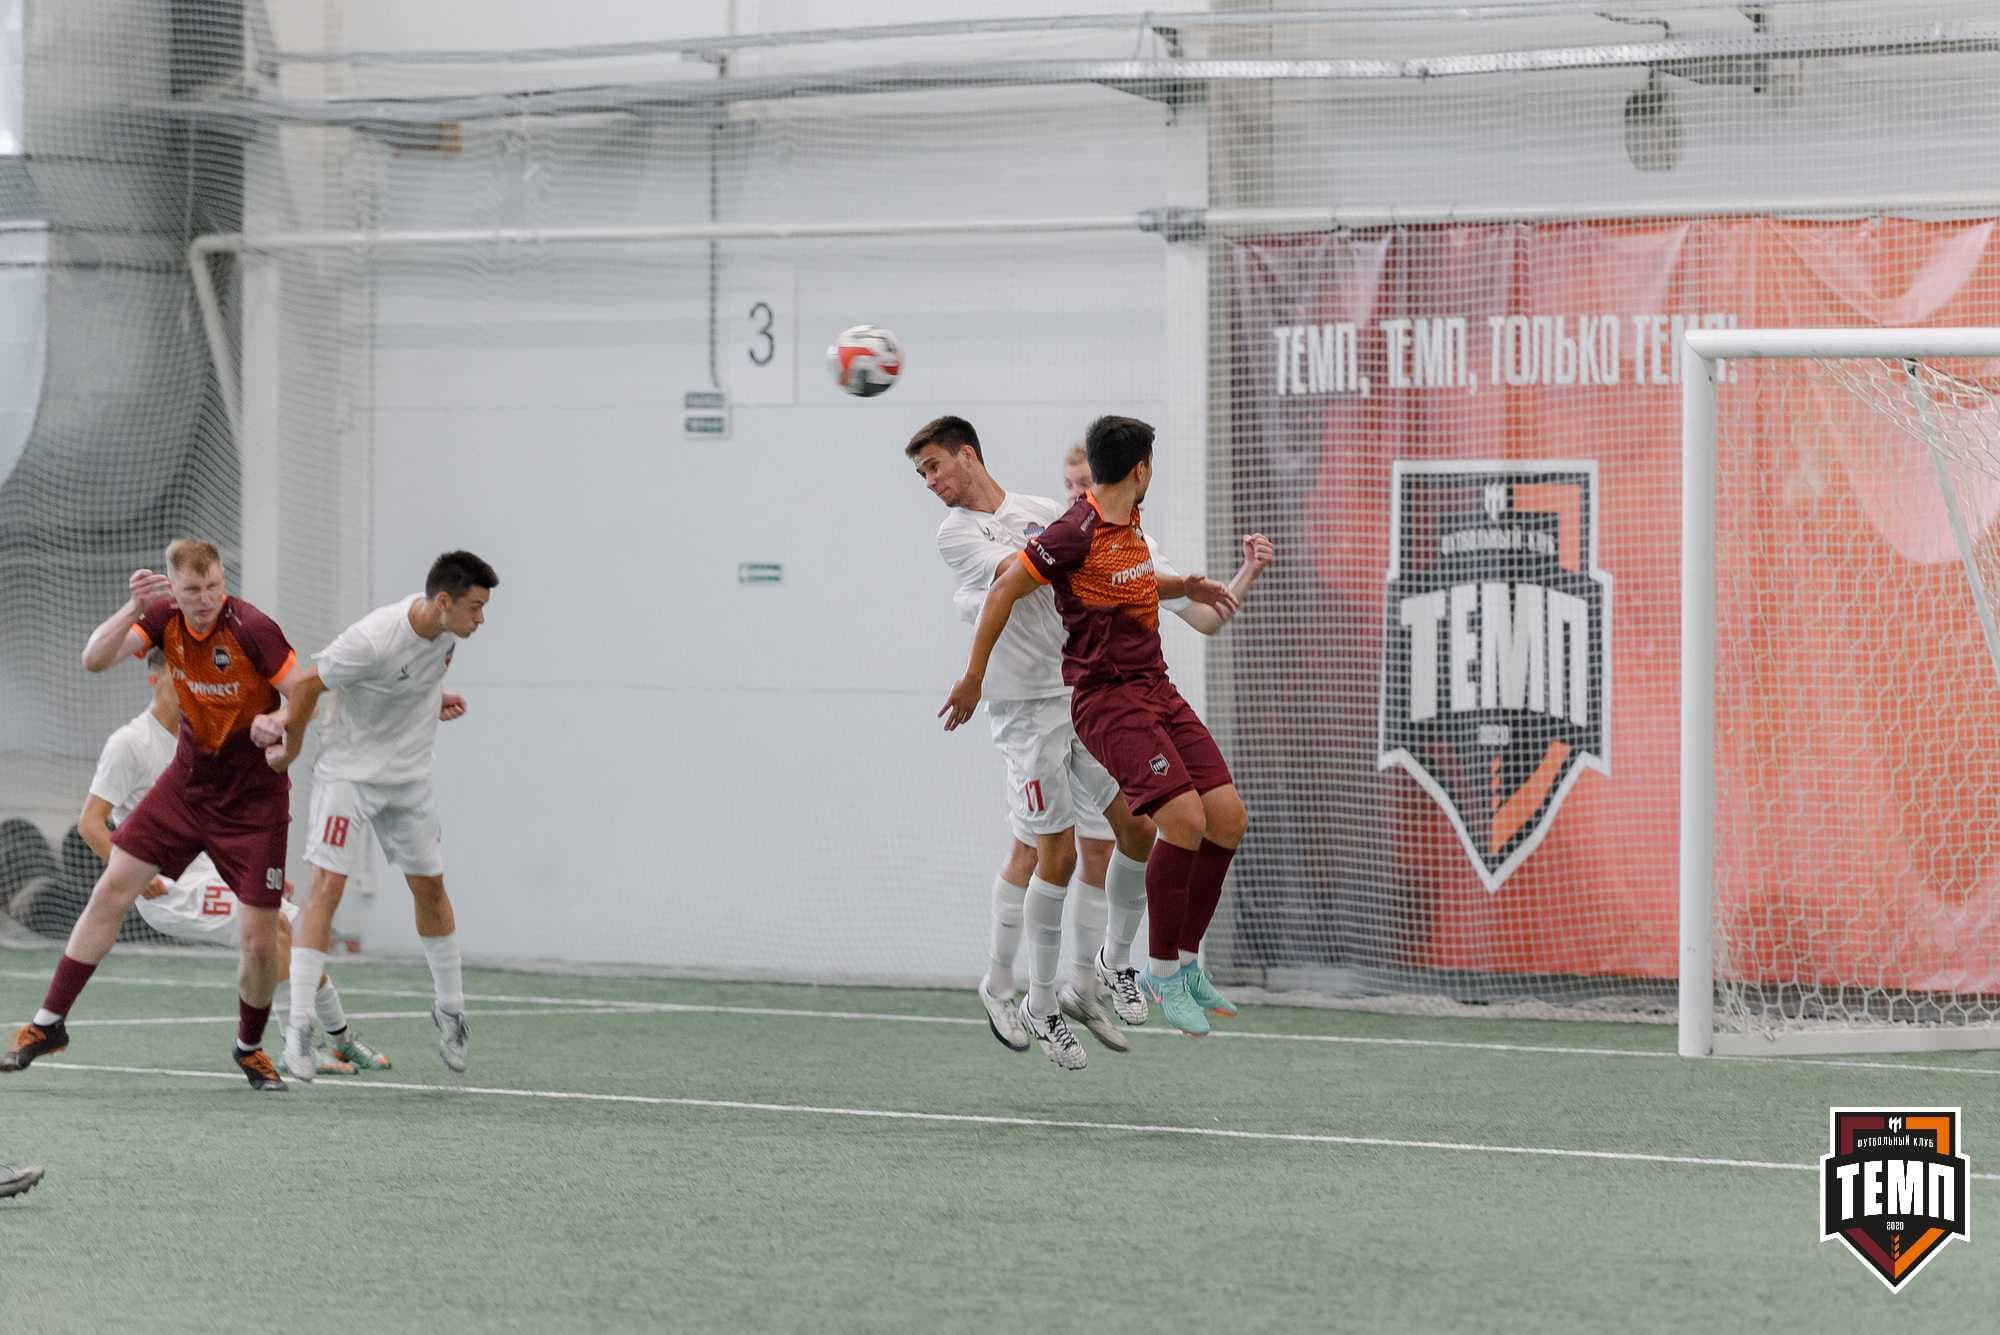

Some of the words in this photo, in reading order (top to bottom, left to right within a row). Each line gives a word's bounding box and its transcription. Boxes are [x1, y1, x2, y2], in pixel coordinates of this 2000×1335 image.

[749, 301, 774, 366] 3
[1274, 322, 1370, 398] ТЕМП,
[1380, 316, 1478, 396] ТЕМП,
[1489, 314, 1621, 386] ТОЛЬКО
[1401, 582, 1588, 728] ТЕМП
[322, 815, 350, 848] 18
